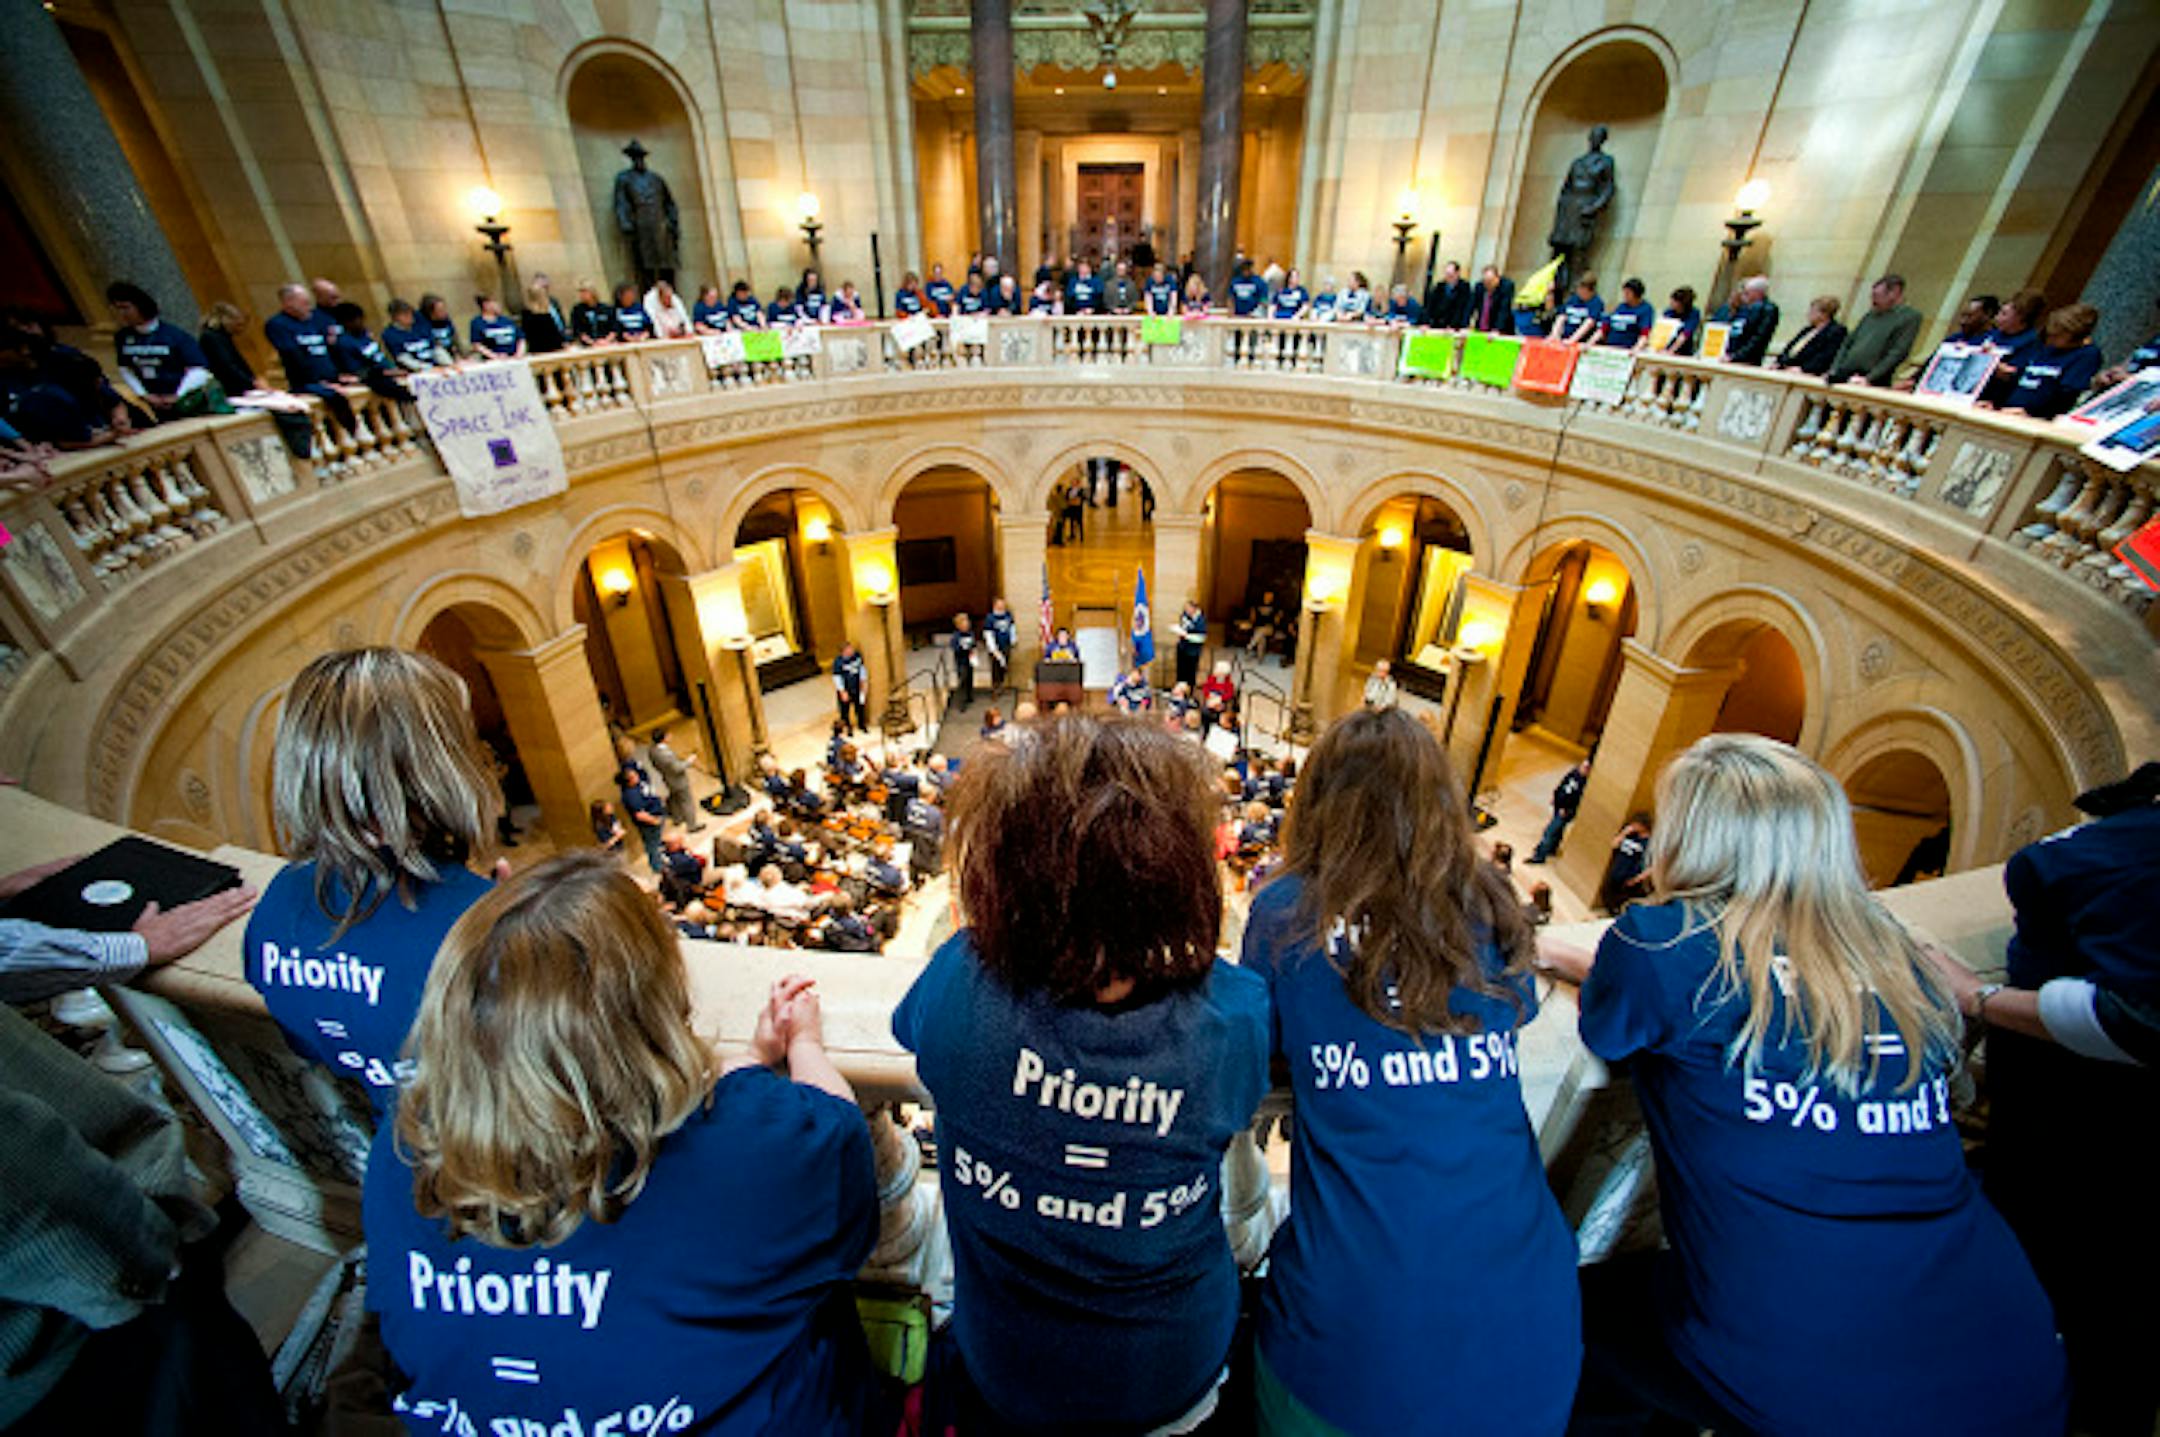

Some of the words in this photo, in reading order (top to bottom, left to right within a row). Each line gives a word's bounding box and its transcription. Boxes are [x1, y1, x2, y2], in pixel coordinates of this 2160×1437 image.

[262, 941, 386, 1006] Priority
[1311, 1041, 1371, 1090] 5%
[1381, 1033, 1460, 1086] and
[1013, 1047, 1185, 1137] Priority
[1743, 1078, 1838, 1132] 5%
[1856, 1082, 1933, 1135] and
[1064, 1143, 1110, 1169] =
[954, 1145, 1021, 1210] 5%
[1036, 1191, 1127, 1229] and
[1140, 1173, 1209, 1229] 5%
[408, 1249, 612, 1329] Priority
[491, 1356, 540, 1385] =
[594, 1395, 695, 1437] 5%
